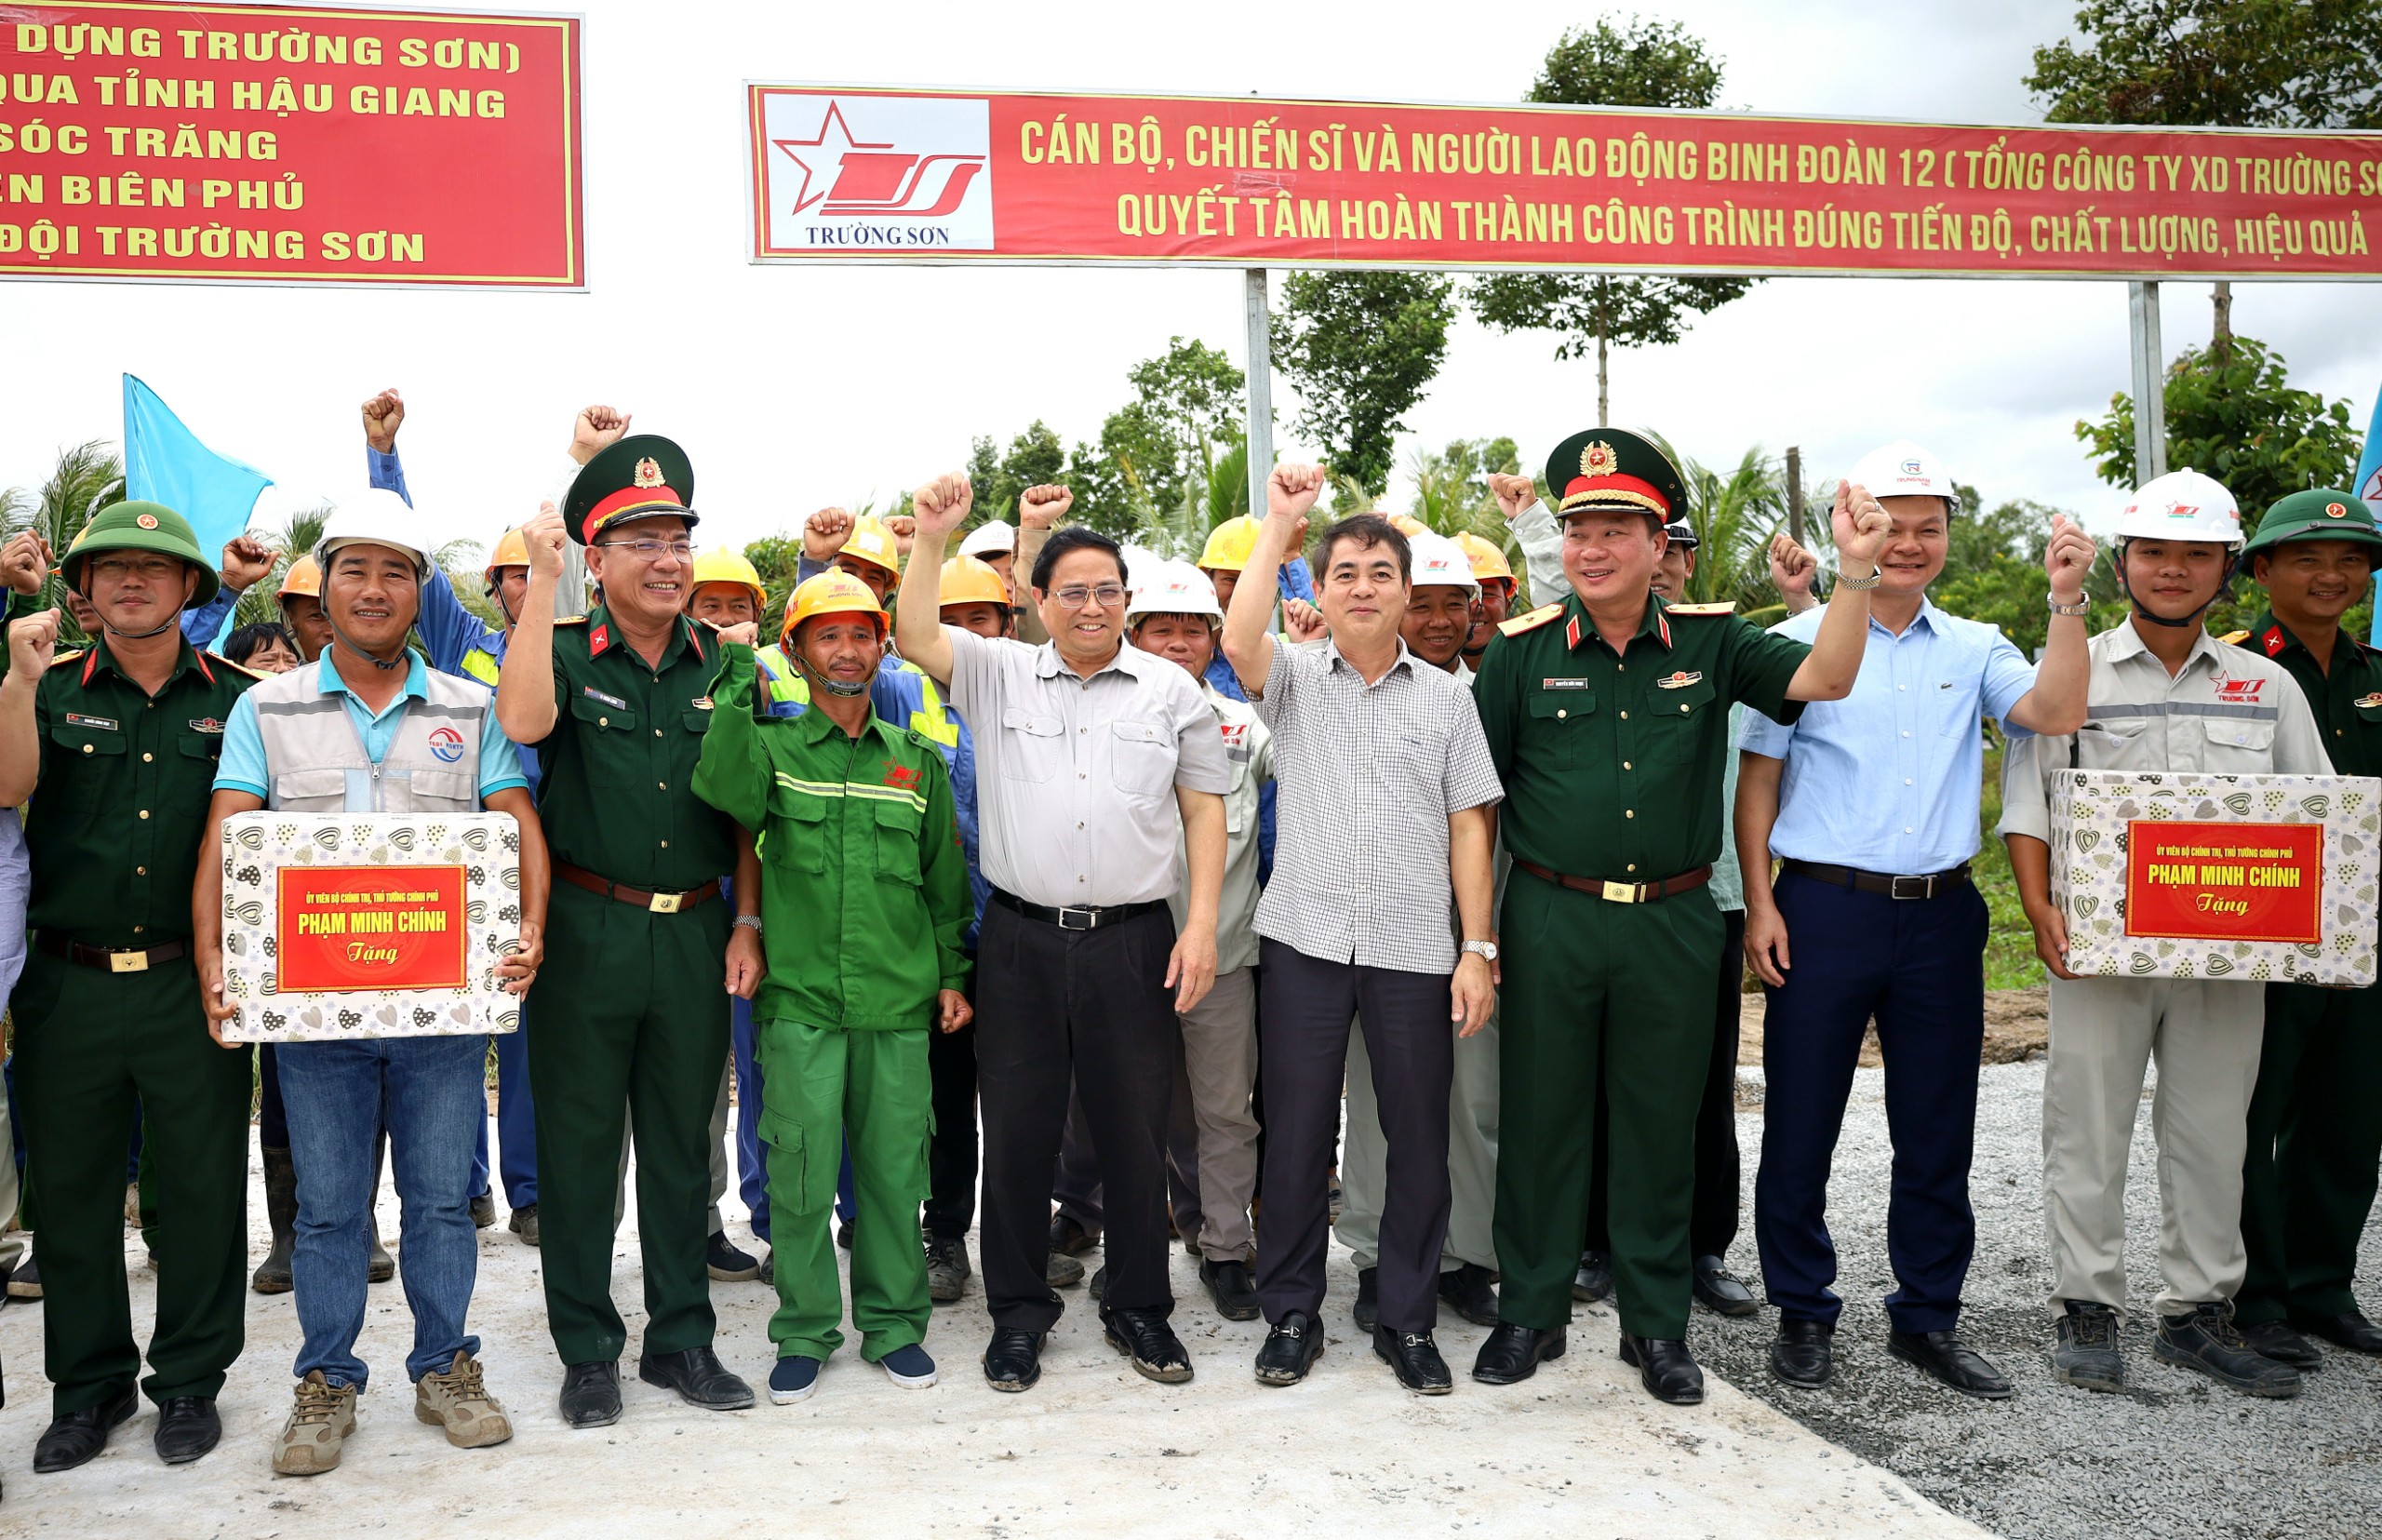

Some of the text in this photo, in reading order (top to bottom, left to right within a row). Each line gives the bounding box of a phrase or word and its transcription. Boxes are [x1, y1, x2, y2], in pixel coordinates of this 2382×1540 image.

[17, 23, 520, 74] DỰNG TRƯỜNG SƠN)
[0, 68, 505, 119] UA TỈNH HẬU GIANG
[104, 123, 277, 161] TRĂNG
[1020, 113, 1101, 165] CÁN
[1111, 114, 1176, 174] BỘ,
[1184, 114, 1299, 170] CHIẾN
[1307, 122, 1348, 172] SĨ
[1351, 123, 1402, 173] VÀ
[1411, 126, 1522, 175] NGƯỜI
[1531, 135, 1598, 178] LAO
[1604, 130, 1698, 187] ĐỘNG
[1706, 141, 1788, 183] BINH
[1796, 138, 1887, 186] ĐOÀN
[1898, 148, 1936, 188] 12
[2050, 146, 2135, 193] CÔNG
[2142, 154, 2183, 192] TY
[2189, 155, 2228, 193] XD
[2235, 152, 2351, 196] TRƯỜNG
[2358, 160, 2382, 196] S
[62, 171, 185, 208] BIÊN
[203, 172, 304, 210] PHỦ
[806, 221, 949, 245] TRƯỜNG SƠN
[1117, 183, 2369, 261] QUYẾT TÂM HOÀN THÀNH CÔNG TRÌNH ĐÚNG TIẾN ĐỘ, CHẤT LƯỢNG, HIỆU QUẢ
[96, 222, 304, 260] TRƯỜNG
[322, 231, 424, 262] SƠN
[2165, 845, 2180, 856] VIÊN
[2181, 845, 2190, 858] BỘ
[2191, 846, 2211, 857] CHÍNH
[2148, 863, 2300, 889] PHẠM MINH CHÍNH
[315, 892, 330, 904] VIÊN
[331, 892, 340, 905] BỘ
[341, 891, 360, 904] CHÍNH
[2196, 892, 2249, 916] Tặng
[298, 906, 447, 939] PHẠM MINH CHÍNH
[346, 942, 398, 965] Tặng
